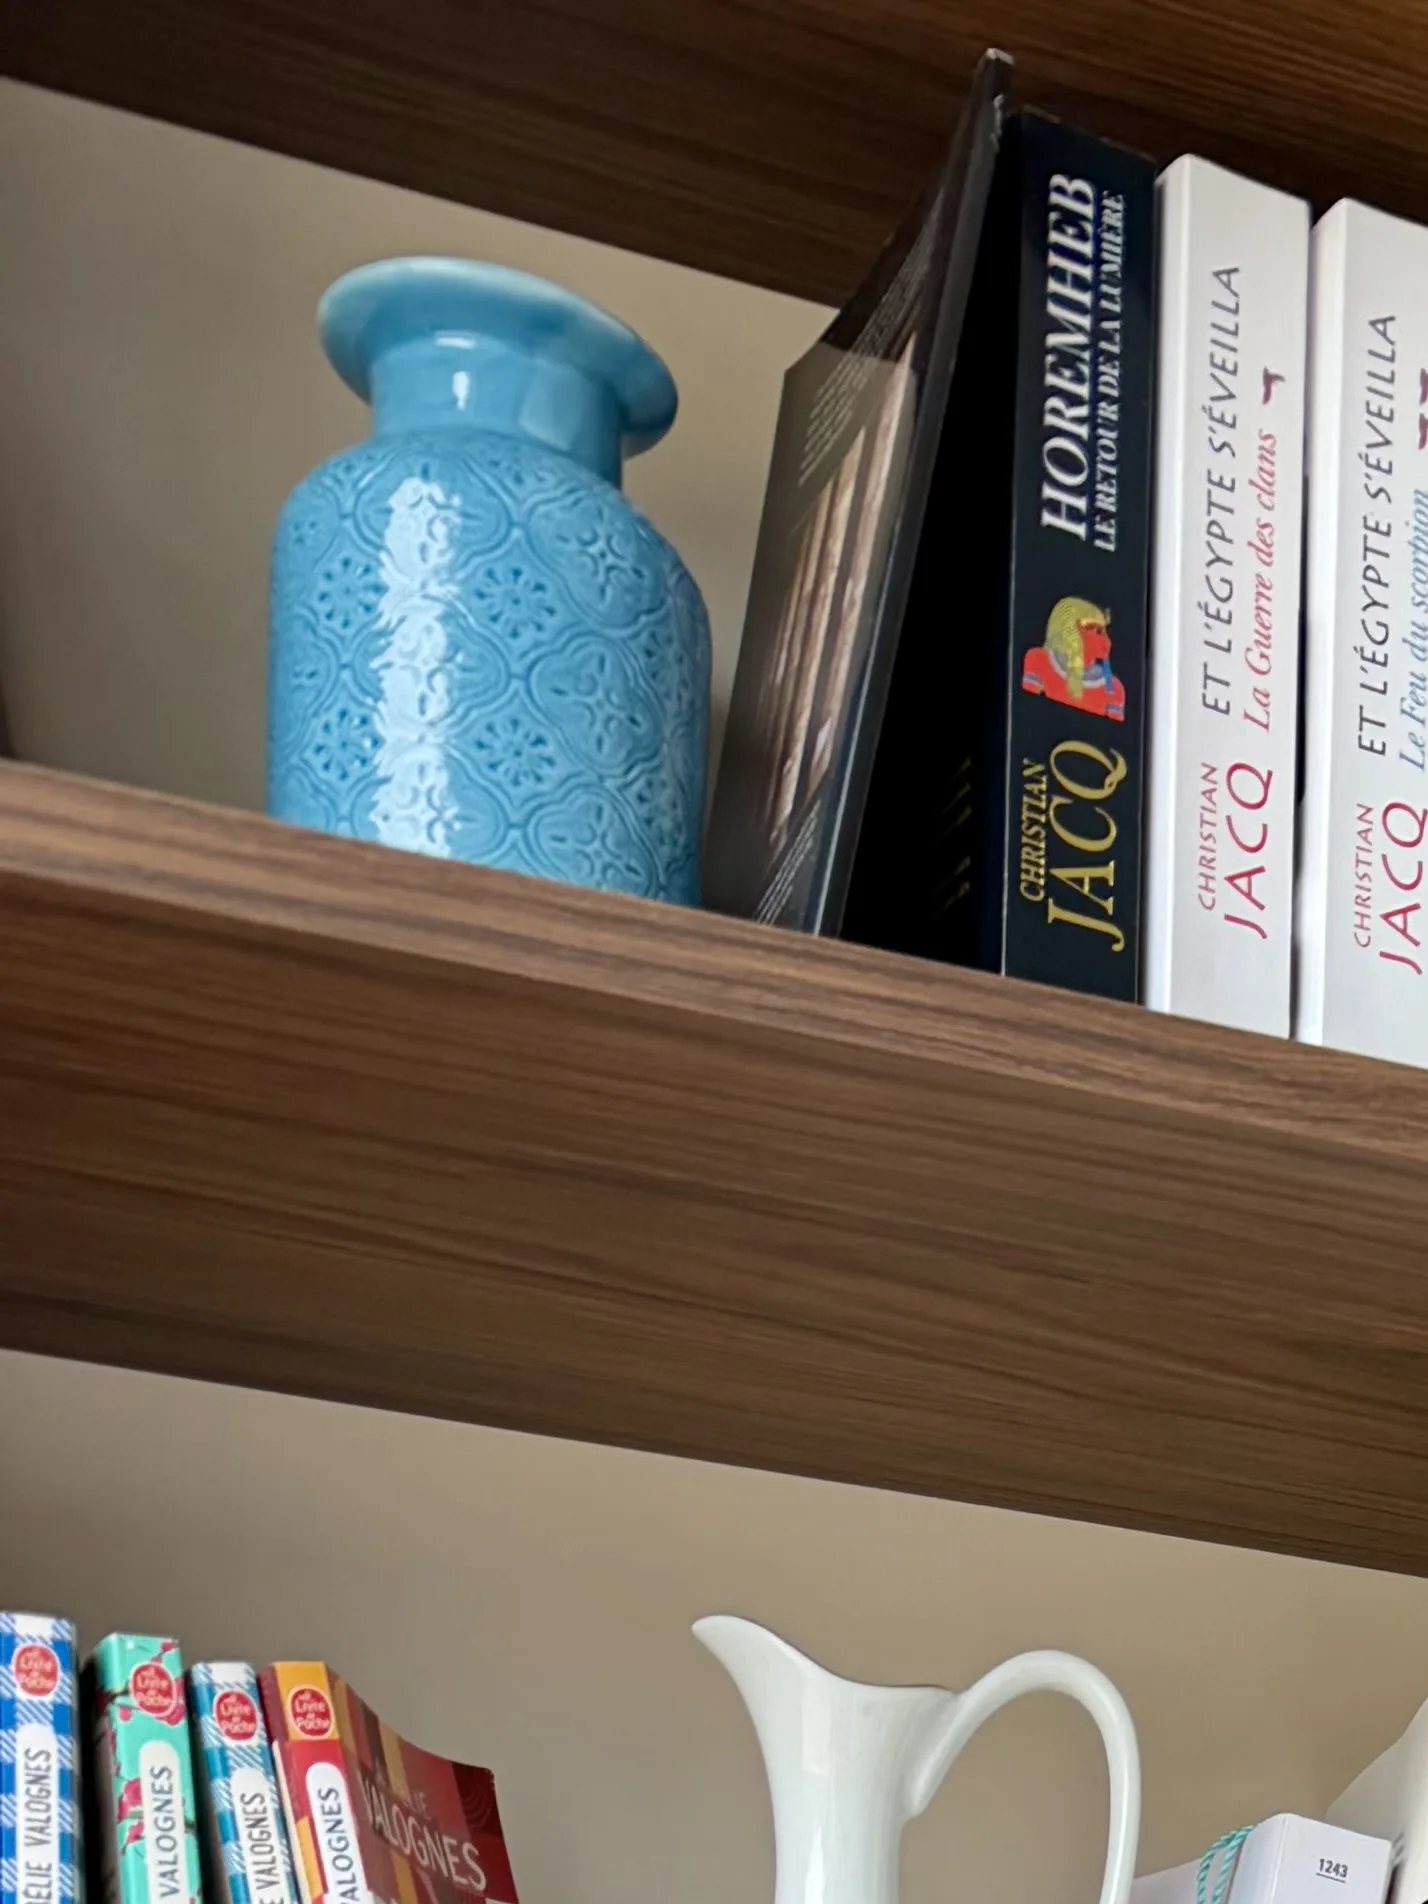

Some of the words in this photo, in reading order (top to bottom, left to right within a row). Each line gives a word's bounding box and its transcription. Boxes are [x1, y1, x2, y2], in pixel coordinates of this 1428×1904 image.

[1100, 190, 1123, 312] LUMIÈRE
[1042, 174, 1093, 539] HOREMHEB
[1098, 357, 1119, 396] DE
[1099, 320, 1120, 354] LA
[1201, 267, 1240, 458] S'ÉVEILLA
[1094, 400, 1118, 517] RETOUR
[1357, 315, 1396, 503] S'ÉVEILLA
[1248, 428, 1276, 511] clans
[1094, 520, 1115, 551] LE
[1197, 468, 1236, 654] L'ÉGYPTE
[1247, 518, 1274, 567] des
[1244, 572, 1273, 676] Guerre
[1352, 515, 1391, 695] L'ÉGYPTE
[1401, 621, 1428, 662] du
[1201, 661, 1230, 715] ET
[1243, 687, 1270, 731] La
[1357, 704, 1386, 756] ET
[1399, 671, 1427, 727] Feu
[1398, 731, 1425, 771] Le
[1020, 758, 1047, 901] CHRISTIAN
[1047, 740, 1127, 952] JACQ
[1198, 762, 1218, 910] CHRISTIAN
[1223, 762, 1273, 939] JACQ
[1353, 803, 1373, 948] CHRISTIAN
[1379, 802, 1428, 975] JACQ
[24, 1748, 51, 1846] VALOGNES
[149, 1766, 179, 1897] VALOGNES
[239, 1792, 280, 1890] VALOGNES
[1319, 1858, 1348, 1878] 1243
